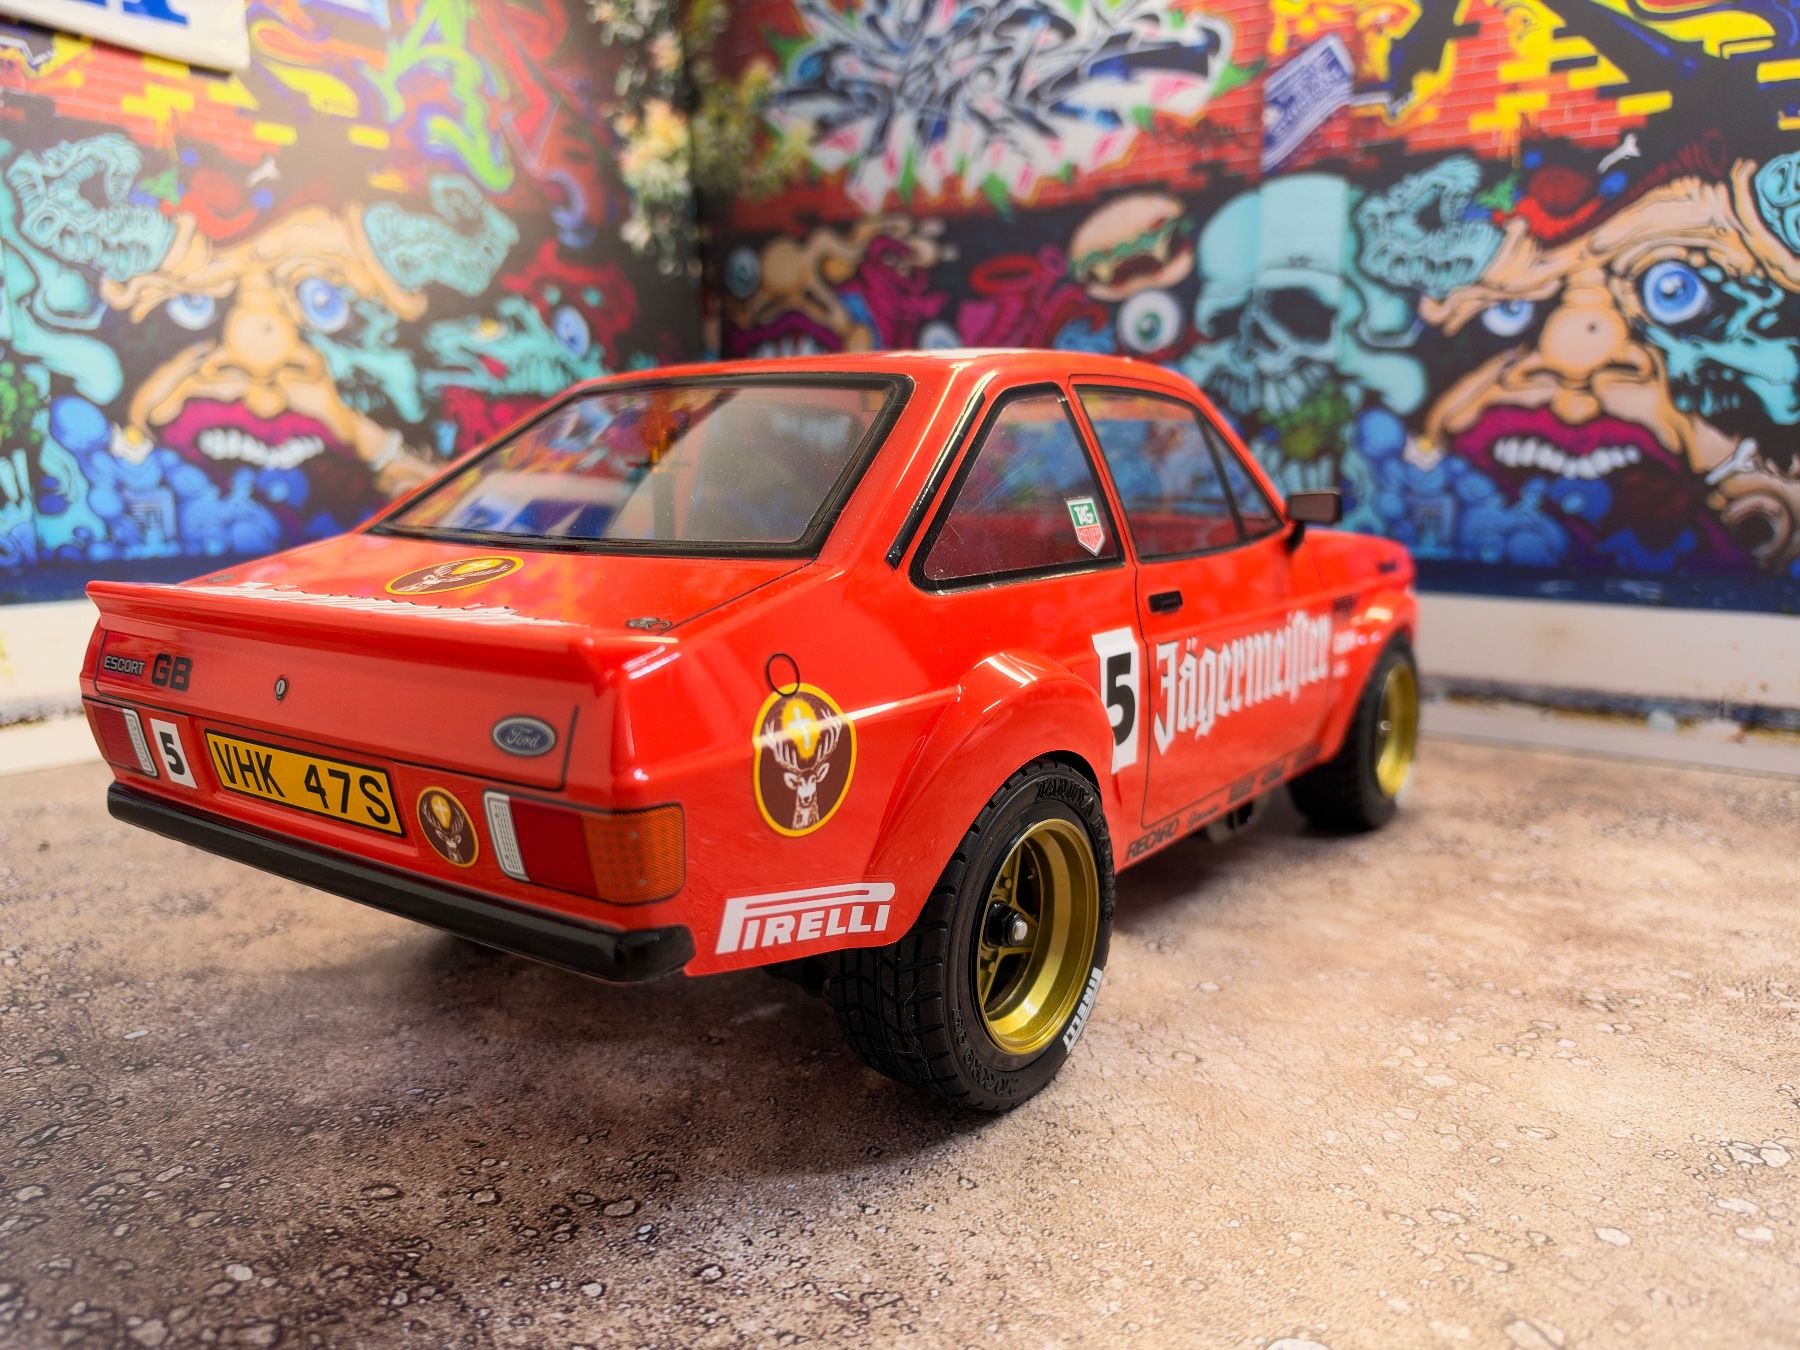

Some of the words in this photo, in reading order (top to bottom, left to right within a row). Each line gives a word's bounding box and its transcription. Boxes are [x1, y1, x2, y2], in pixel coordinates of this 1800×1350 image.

[103, 655, 146, 676] ESCORT
[152, 652, 192, 691] GB
[1106, 651, 1136, 747] 5
[159, 731, 186, 775] 5
[506, 725, 542, 748] Ford
[213, 741, 286, 798] VHK
[304, 764, 391, 826] 47S
[1125, 818, 1180, 862] RECARO
[714, 882, 896, 955] PIRELLI
[1062, 966, 1104, 1055] PIRELLI
